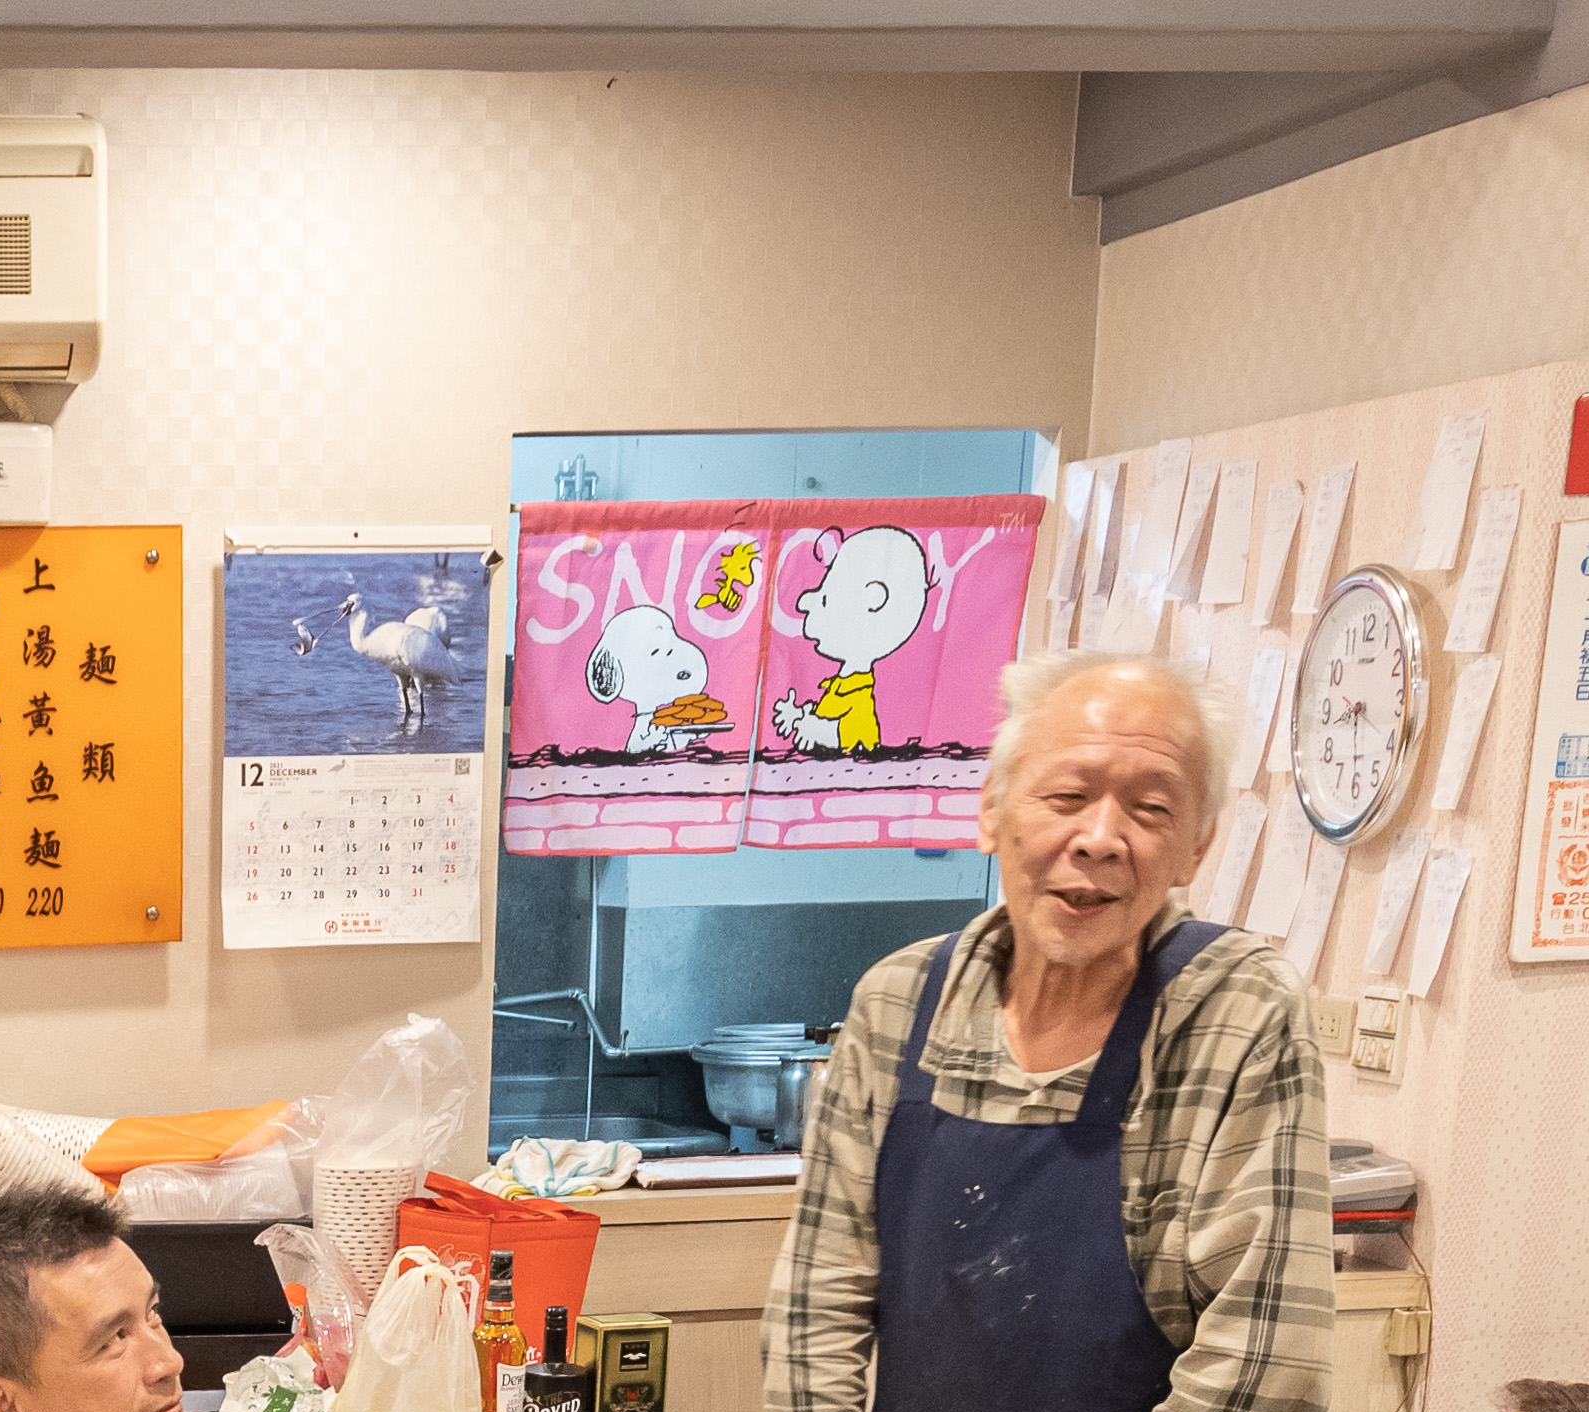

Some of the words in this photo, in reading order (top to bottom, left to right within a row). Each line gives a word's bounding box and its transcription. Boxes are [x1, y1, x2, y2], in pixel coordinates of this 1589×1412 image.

[525, 526, 996, 644] SNOOY
[1345, 627, 1357, 656] 11
[1362, 613, 1376, 643] 12
[1384, 621, 1390, 650] 1
[1329, 658, 1343, 688] 10
[1391, 648, 1402, 677] 2
[22, 557, 64, 870] 上湯黃魚麵
[77, 640, 119, 785] 麵類
[1321, 697, 1332, 725] 9
[1323, 736, 1333, 764] 8
[1386, 728, 1396, 754] 4
[240, 762, 265, 788] 12
[269, 768, 318, 777] DECEMBER
[1335, 762, 1345, 790] 7
[1351, 771, 1361, 801] 6
[1370, 759, 1381, 789] 5
[413, 818, 424, 828] 10
[446, 818, 456, 827] 11
[247, 845, 258, 855] 12
[280, 845, 291, 854] 13
[313, 844, 324, 853] 14
[346, 843, 357, 852] 15
[379, 842, 390, 852] 16
[412, 842, 423, 851] 17
[446, 841, 457, 850] 18
[247, 869, 258, 878] 19
[279, 868, 292, 877] 20
[313, 867, 323, 877] 21
[346, 866, 357, 876] 22
[379, 866, 390, 875] 23
[412, 865, 423, 874] 24
[445, 864, 456, 873] 25
[24, 885, 65, 918] 220
[246, 892, 258, 901] 26
[280, 891, 292, 900] 27
[313, 890, 324, 900] 28
[346, 889, 357, 899] 29
[379, 889, 390, 898] 30
[412, 888, 423, 897] 31
